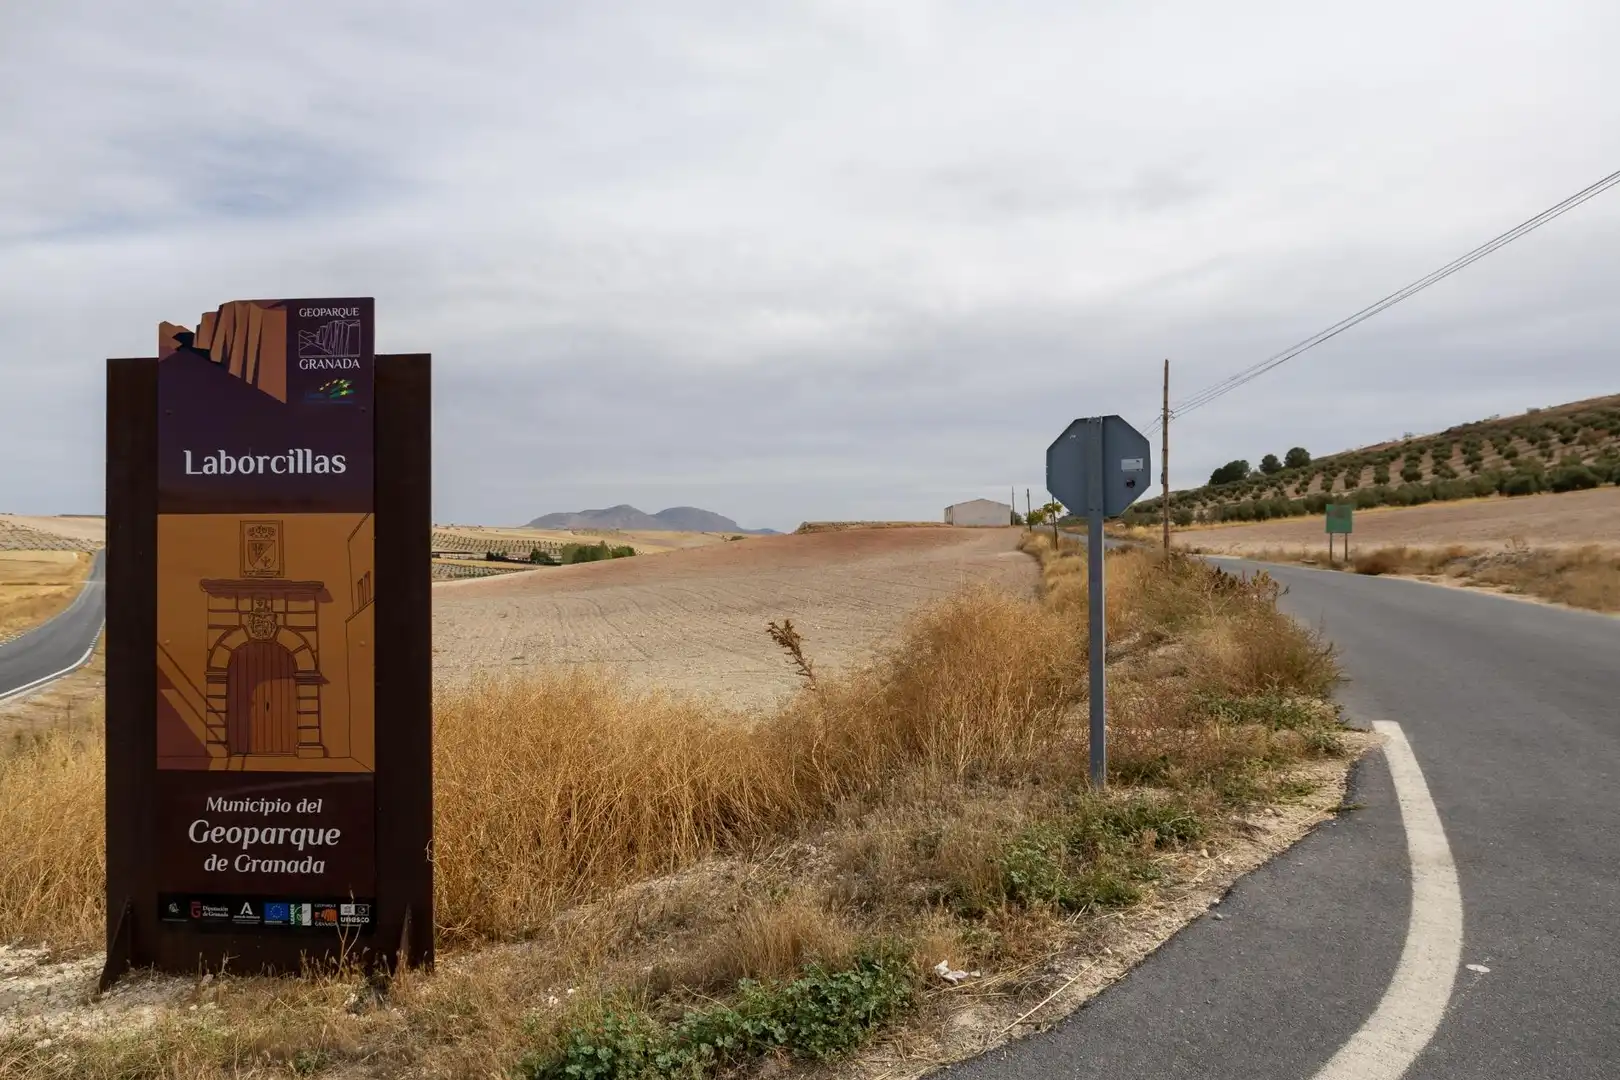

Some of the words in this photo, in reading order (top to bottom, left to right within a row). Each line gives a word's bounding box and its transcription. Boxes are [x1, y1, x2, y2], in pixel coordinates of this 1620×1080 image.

[299, 307, 360, 318] GEOPARQUE
[299, 358, 361, 370] GRANADA
[183, 448, 347, 475] Laborcillas
[206, 796, 292, 816] Municipio
[296, 798, 323, 814] del
[188, 819, 341, 851] Geoparque
[204, 853, 229, 872] de
[234, 854, 325, 874] Granada
